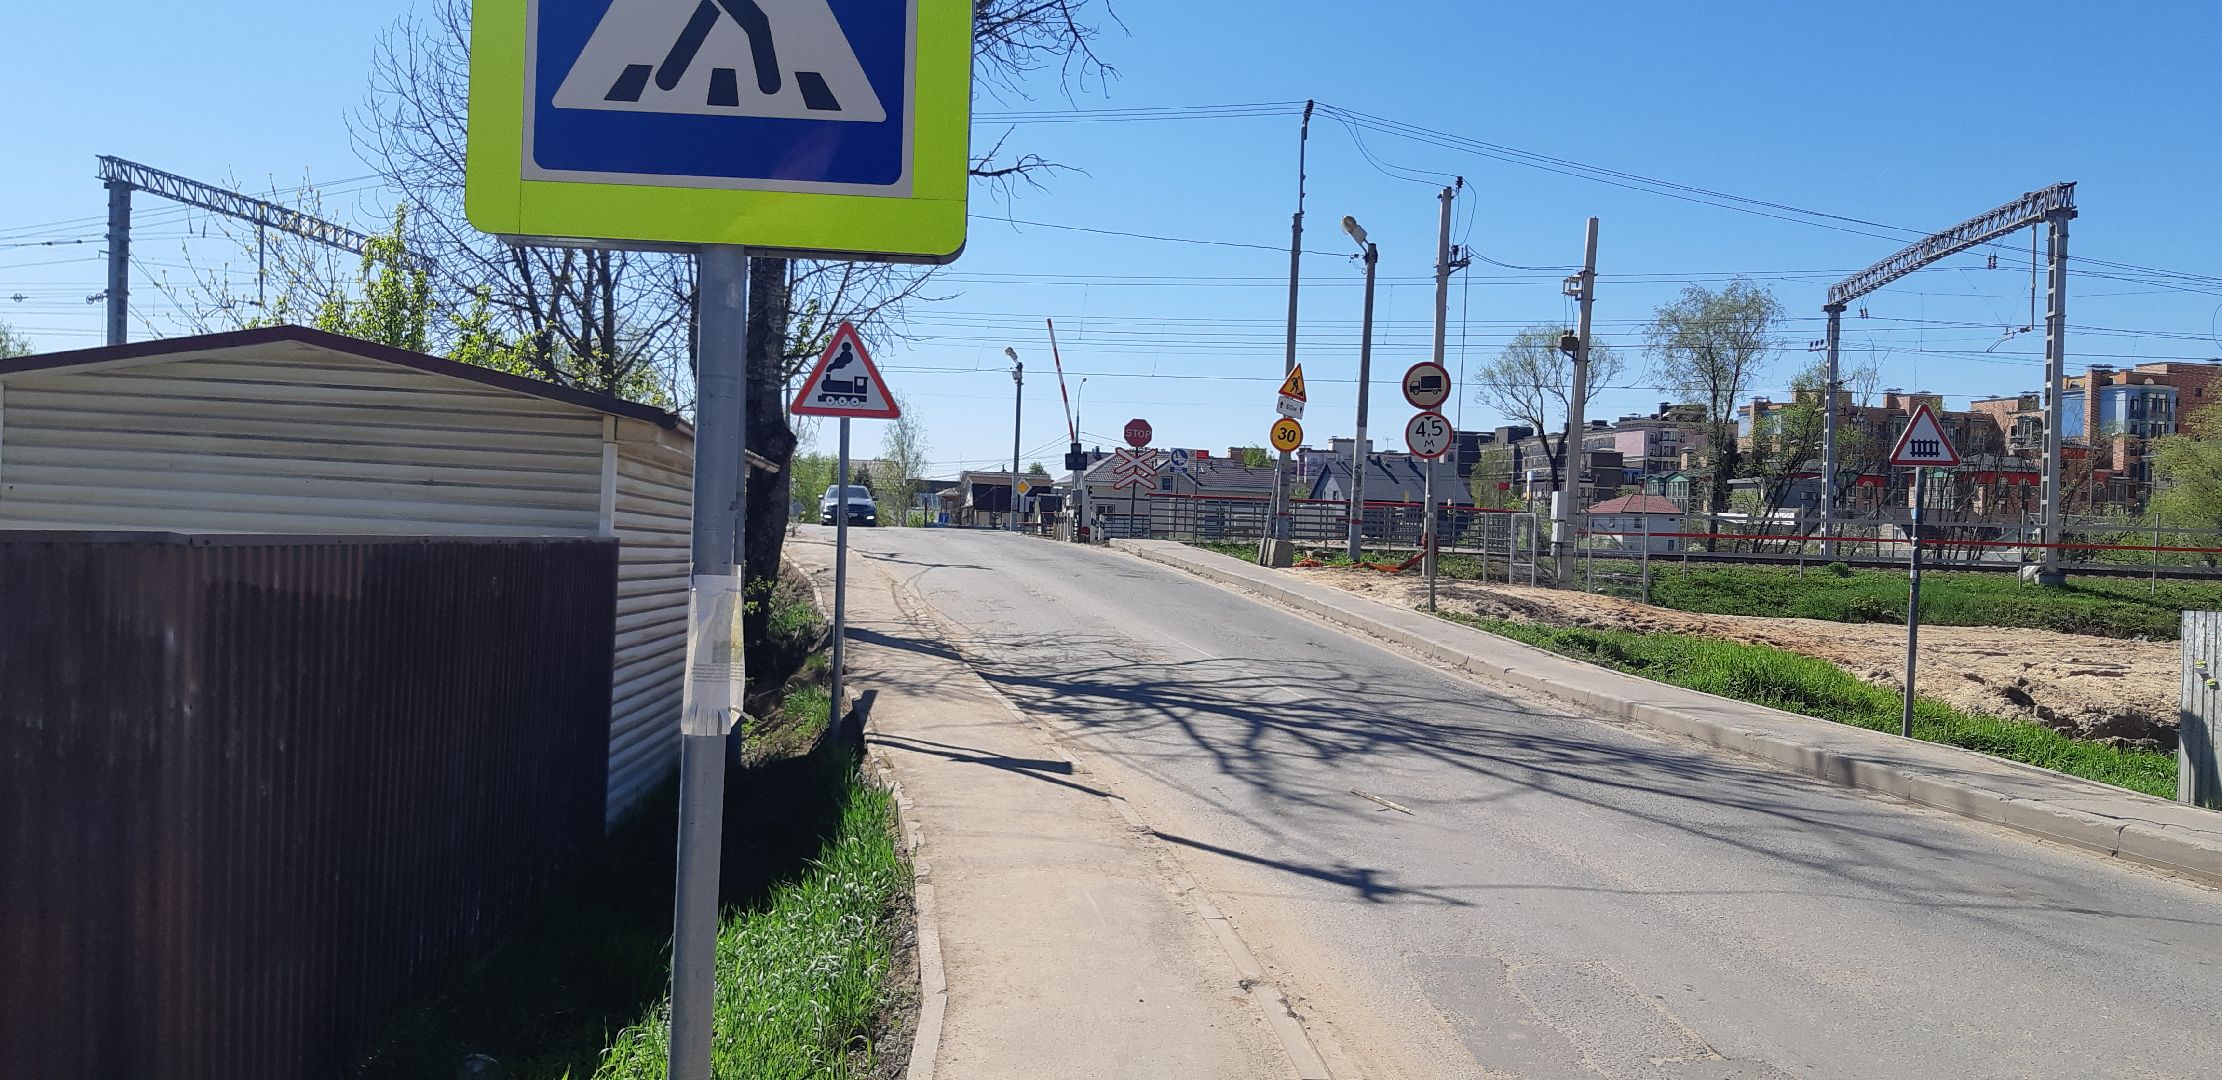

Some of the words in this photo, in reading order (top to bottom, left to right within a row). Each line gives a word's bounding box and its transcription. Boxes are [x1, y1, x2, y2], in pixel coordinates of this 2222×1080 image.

[1125, 428, 1151, 438] STOP
[1278, 427, 1296, 442] 30
[1415, 420, 1443, 438] 4,5
